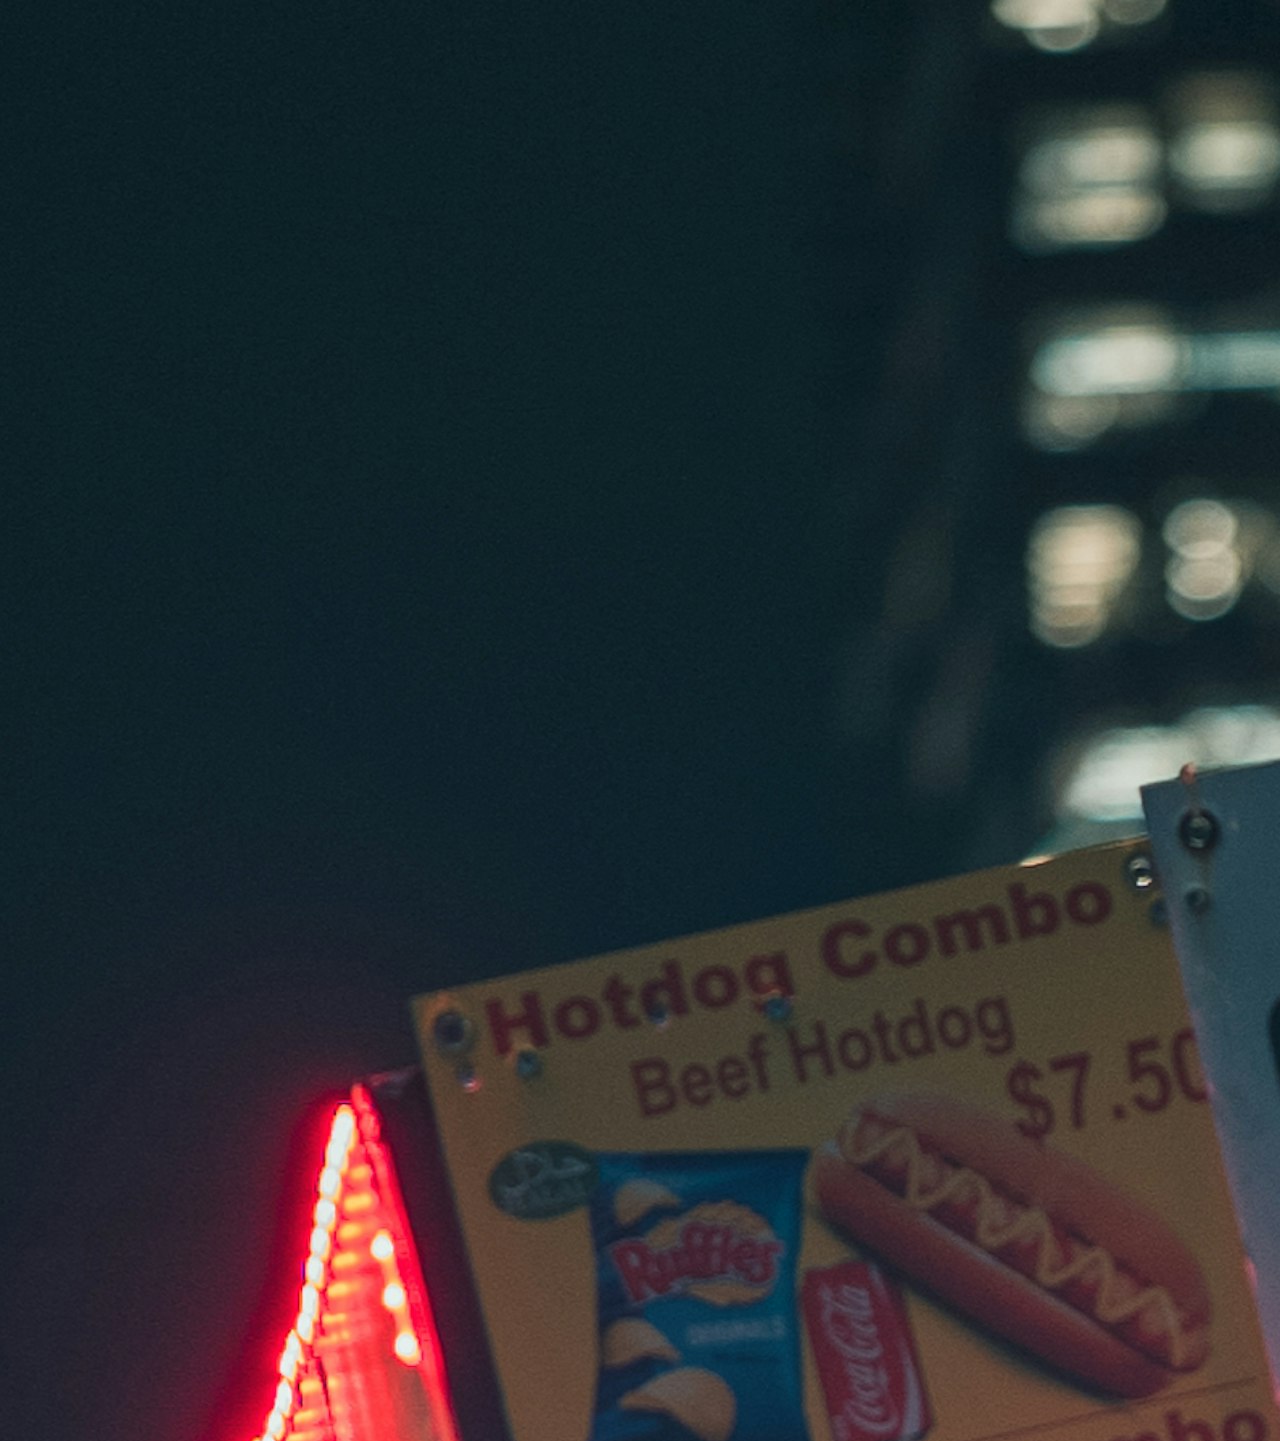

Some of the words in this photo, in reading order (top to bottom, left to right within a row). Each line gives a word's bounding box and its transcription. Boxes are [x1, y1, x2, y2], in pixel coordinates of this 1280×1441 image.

[487, 946, 795, 1057] Hotdog
[820, 880, 1114, 980] Combo
[630, 1038, 772, 1119] Beef
[786, 994, 1015, 1086] Hotdog
[611, 1221, 784, 1304] Ruffles
